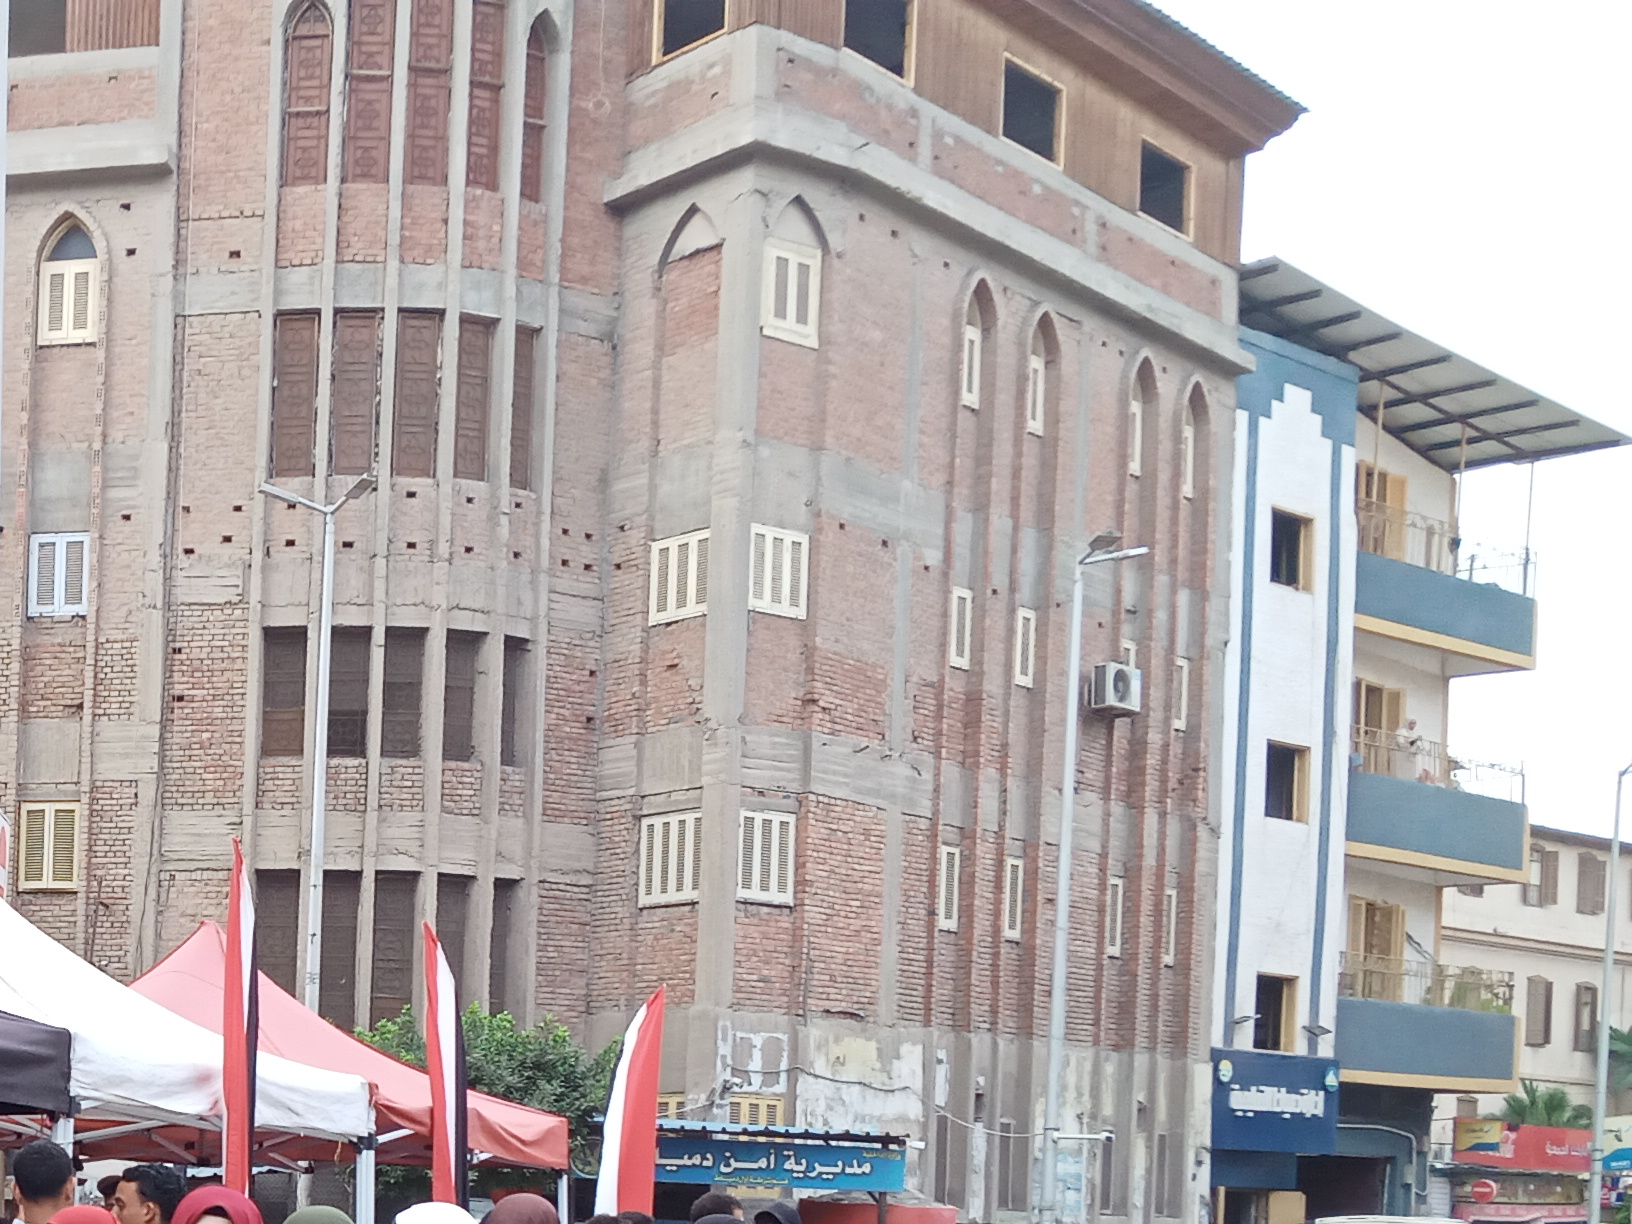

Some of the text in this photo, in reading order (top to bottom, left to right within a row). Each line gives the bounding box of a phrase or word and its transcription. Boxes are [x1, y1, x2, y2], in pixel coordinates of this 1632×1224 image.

[655, 1147, 872, 1178] مديرية أمن دميا
